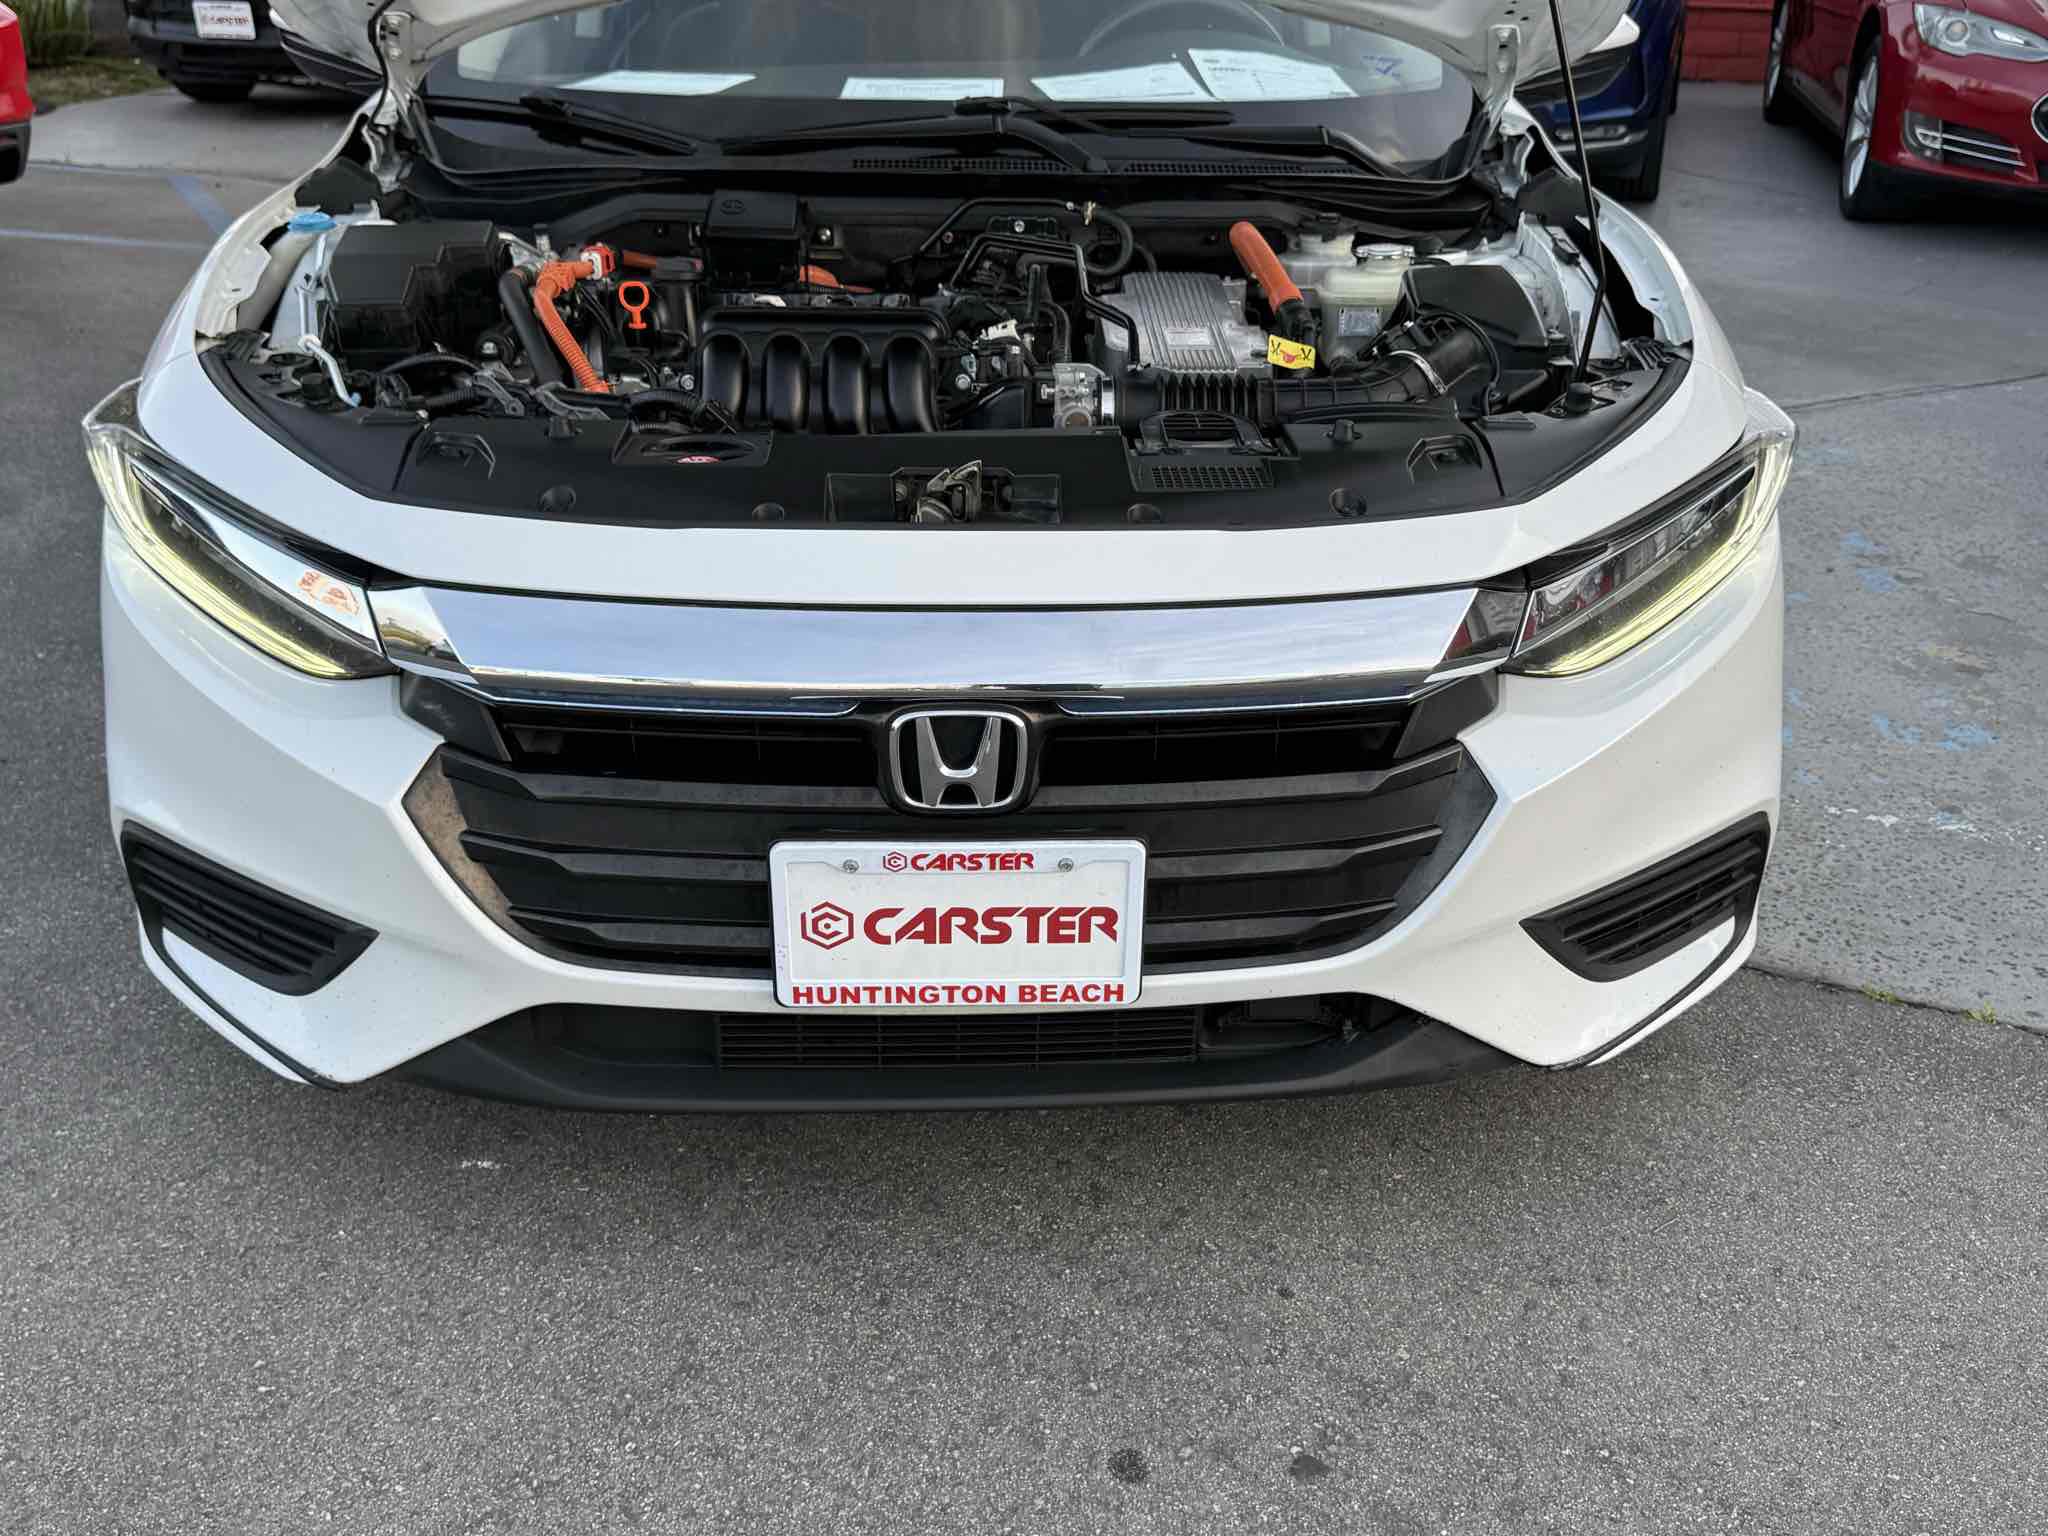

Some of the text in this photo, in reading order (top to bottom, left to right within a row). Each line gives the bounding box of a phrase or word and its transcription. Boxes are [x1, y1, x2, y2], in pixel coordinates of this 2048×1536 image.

[910, 852, 1034, 872] CARSTER
[863, 906, 1118, 945] CARSTER
[792, 984, 1125, 1005] HUNTINGTON BEACH
